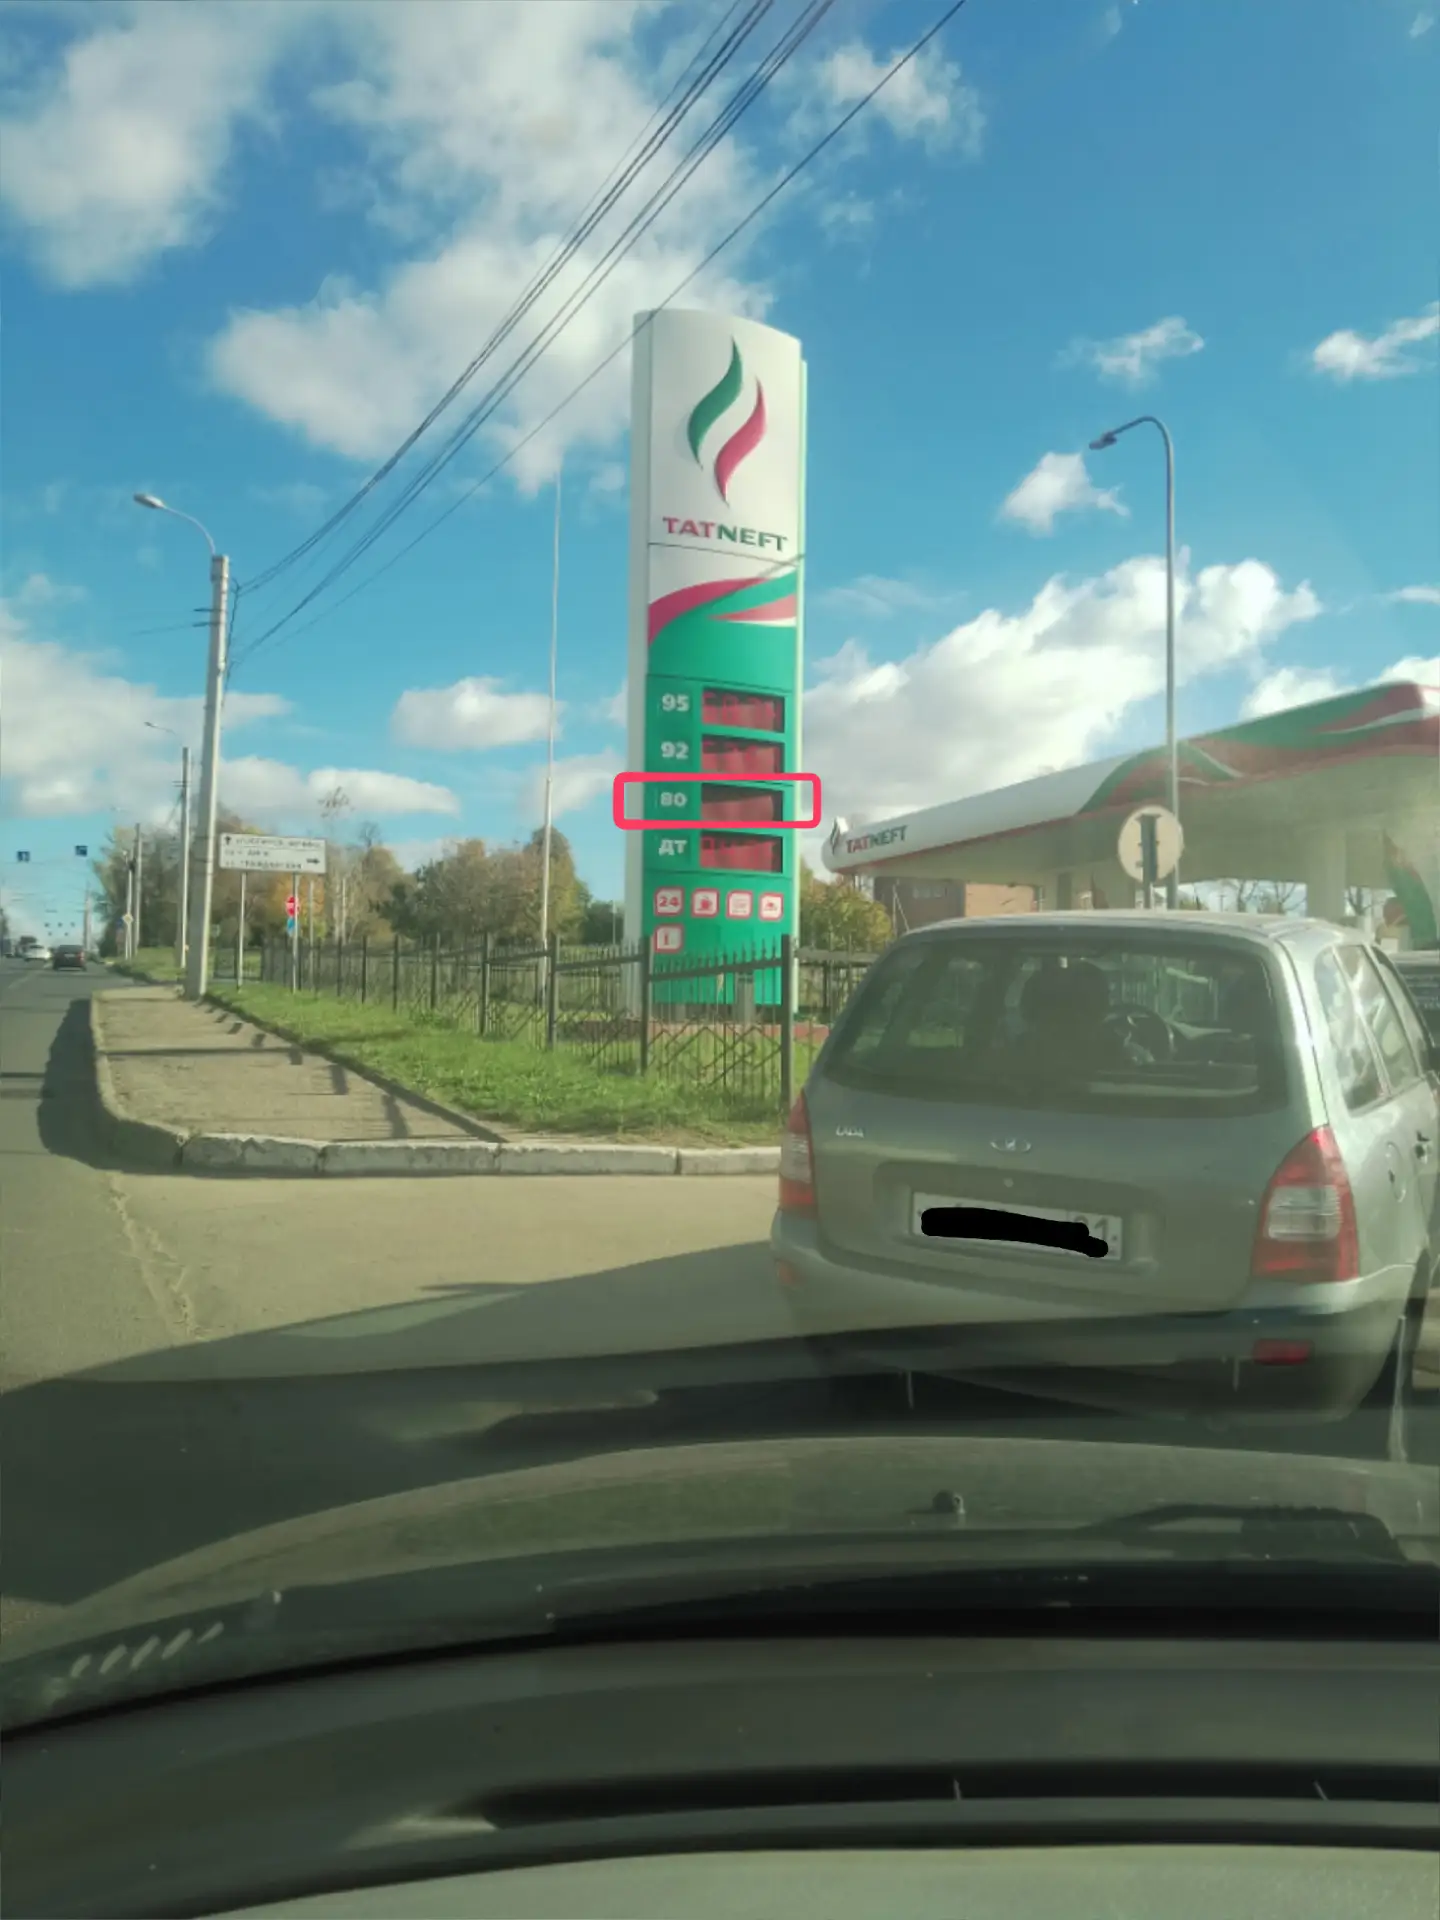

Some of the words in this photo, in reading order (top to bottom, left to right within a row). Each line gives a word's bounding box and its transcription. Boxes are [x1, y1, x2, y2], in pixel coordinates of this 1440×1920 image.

[662, 515, 789, 551] TATNEFT
[660, 692, 690, 713] 95
[660, 741, 690, 760] 92
[660, 791, 688, 808] 80
[658, 838, 687, 856] ДТ
[845, 824, 908, 854] TATNEFT
[657, 895, 681, 908] 24
